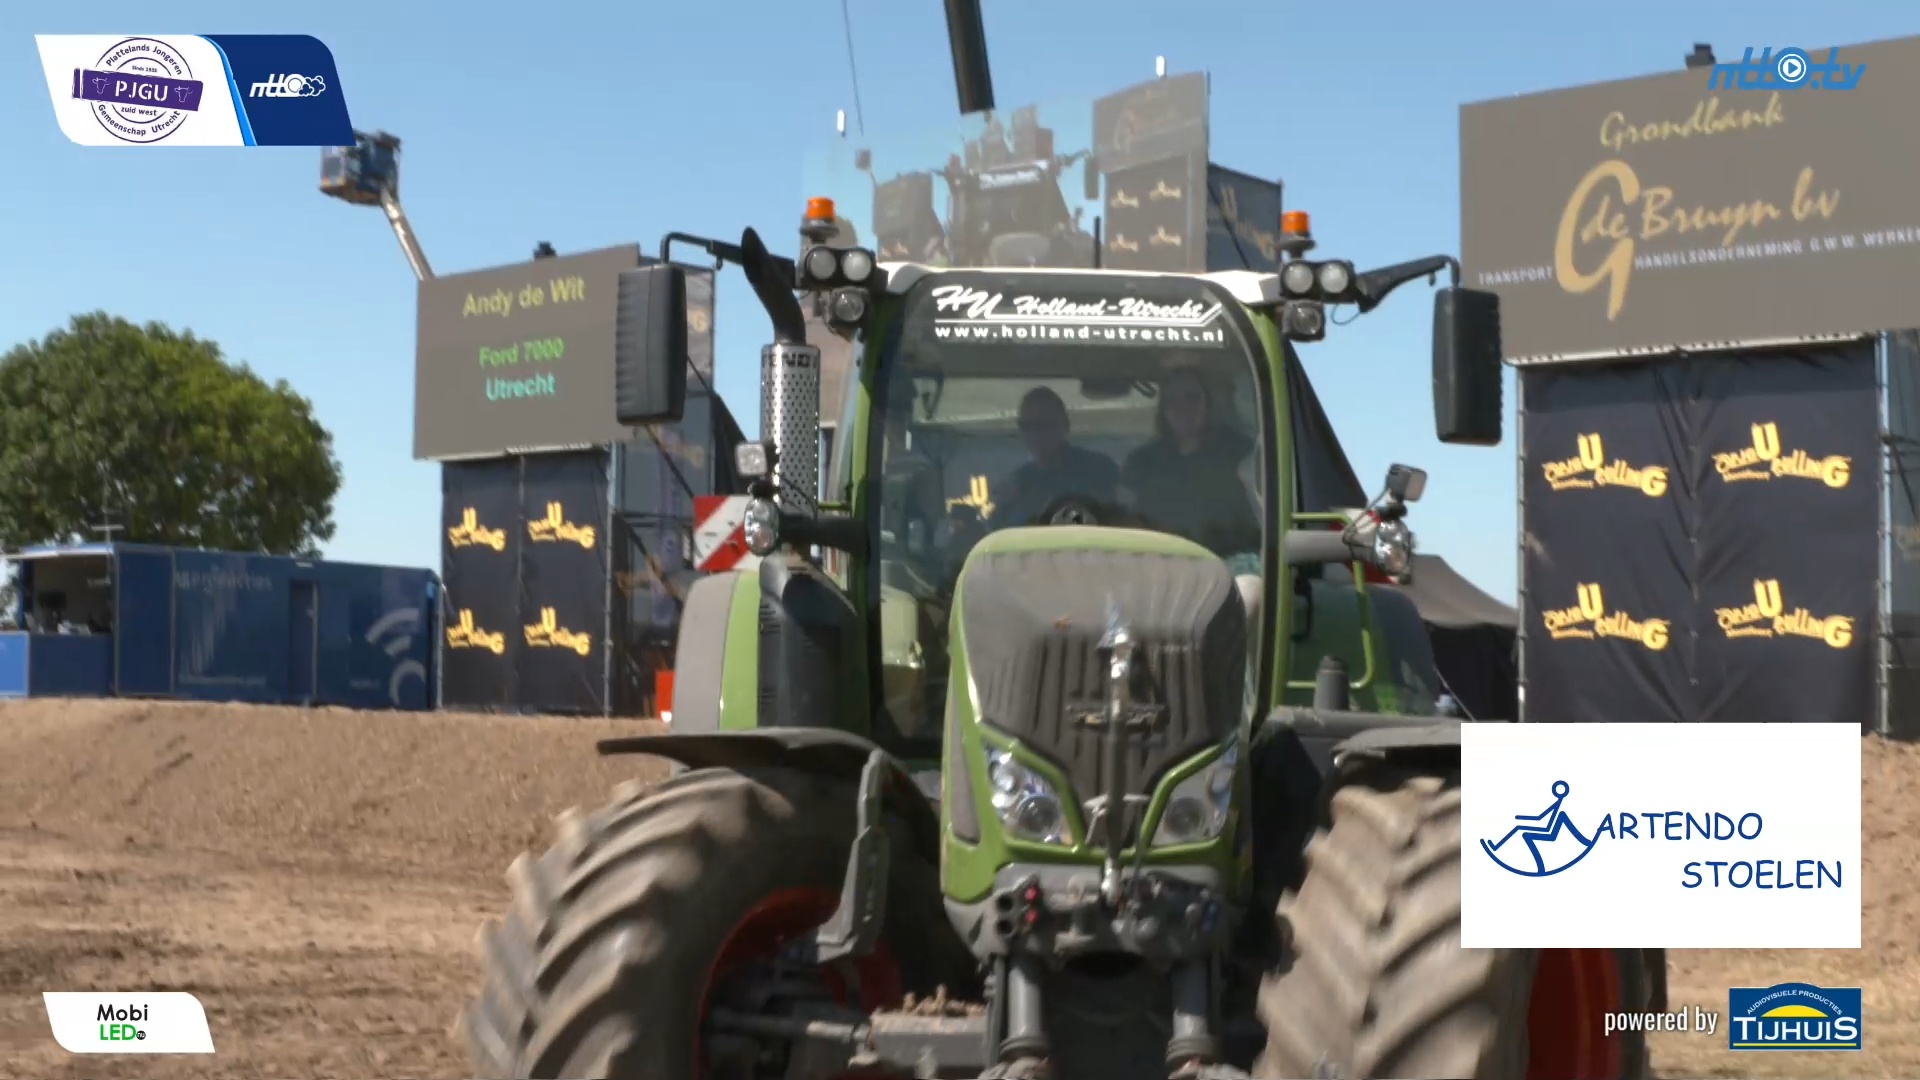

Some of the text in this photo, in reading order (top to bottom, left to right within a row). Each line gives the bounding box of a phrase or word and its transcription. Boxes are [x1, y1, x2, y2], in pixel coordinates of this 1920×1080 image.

[1601, 91, 1784, 151] Grondbank
[462, 274, 586, 317] Andy de Wit
[935, 324, 1224, 343] www.holland-utrecht.nl
[479, 343, 518, 369] Ford
[486, 372, 556, 401] Utrecht
